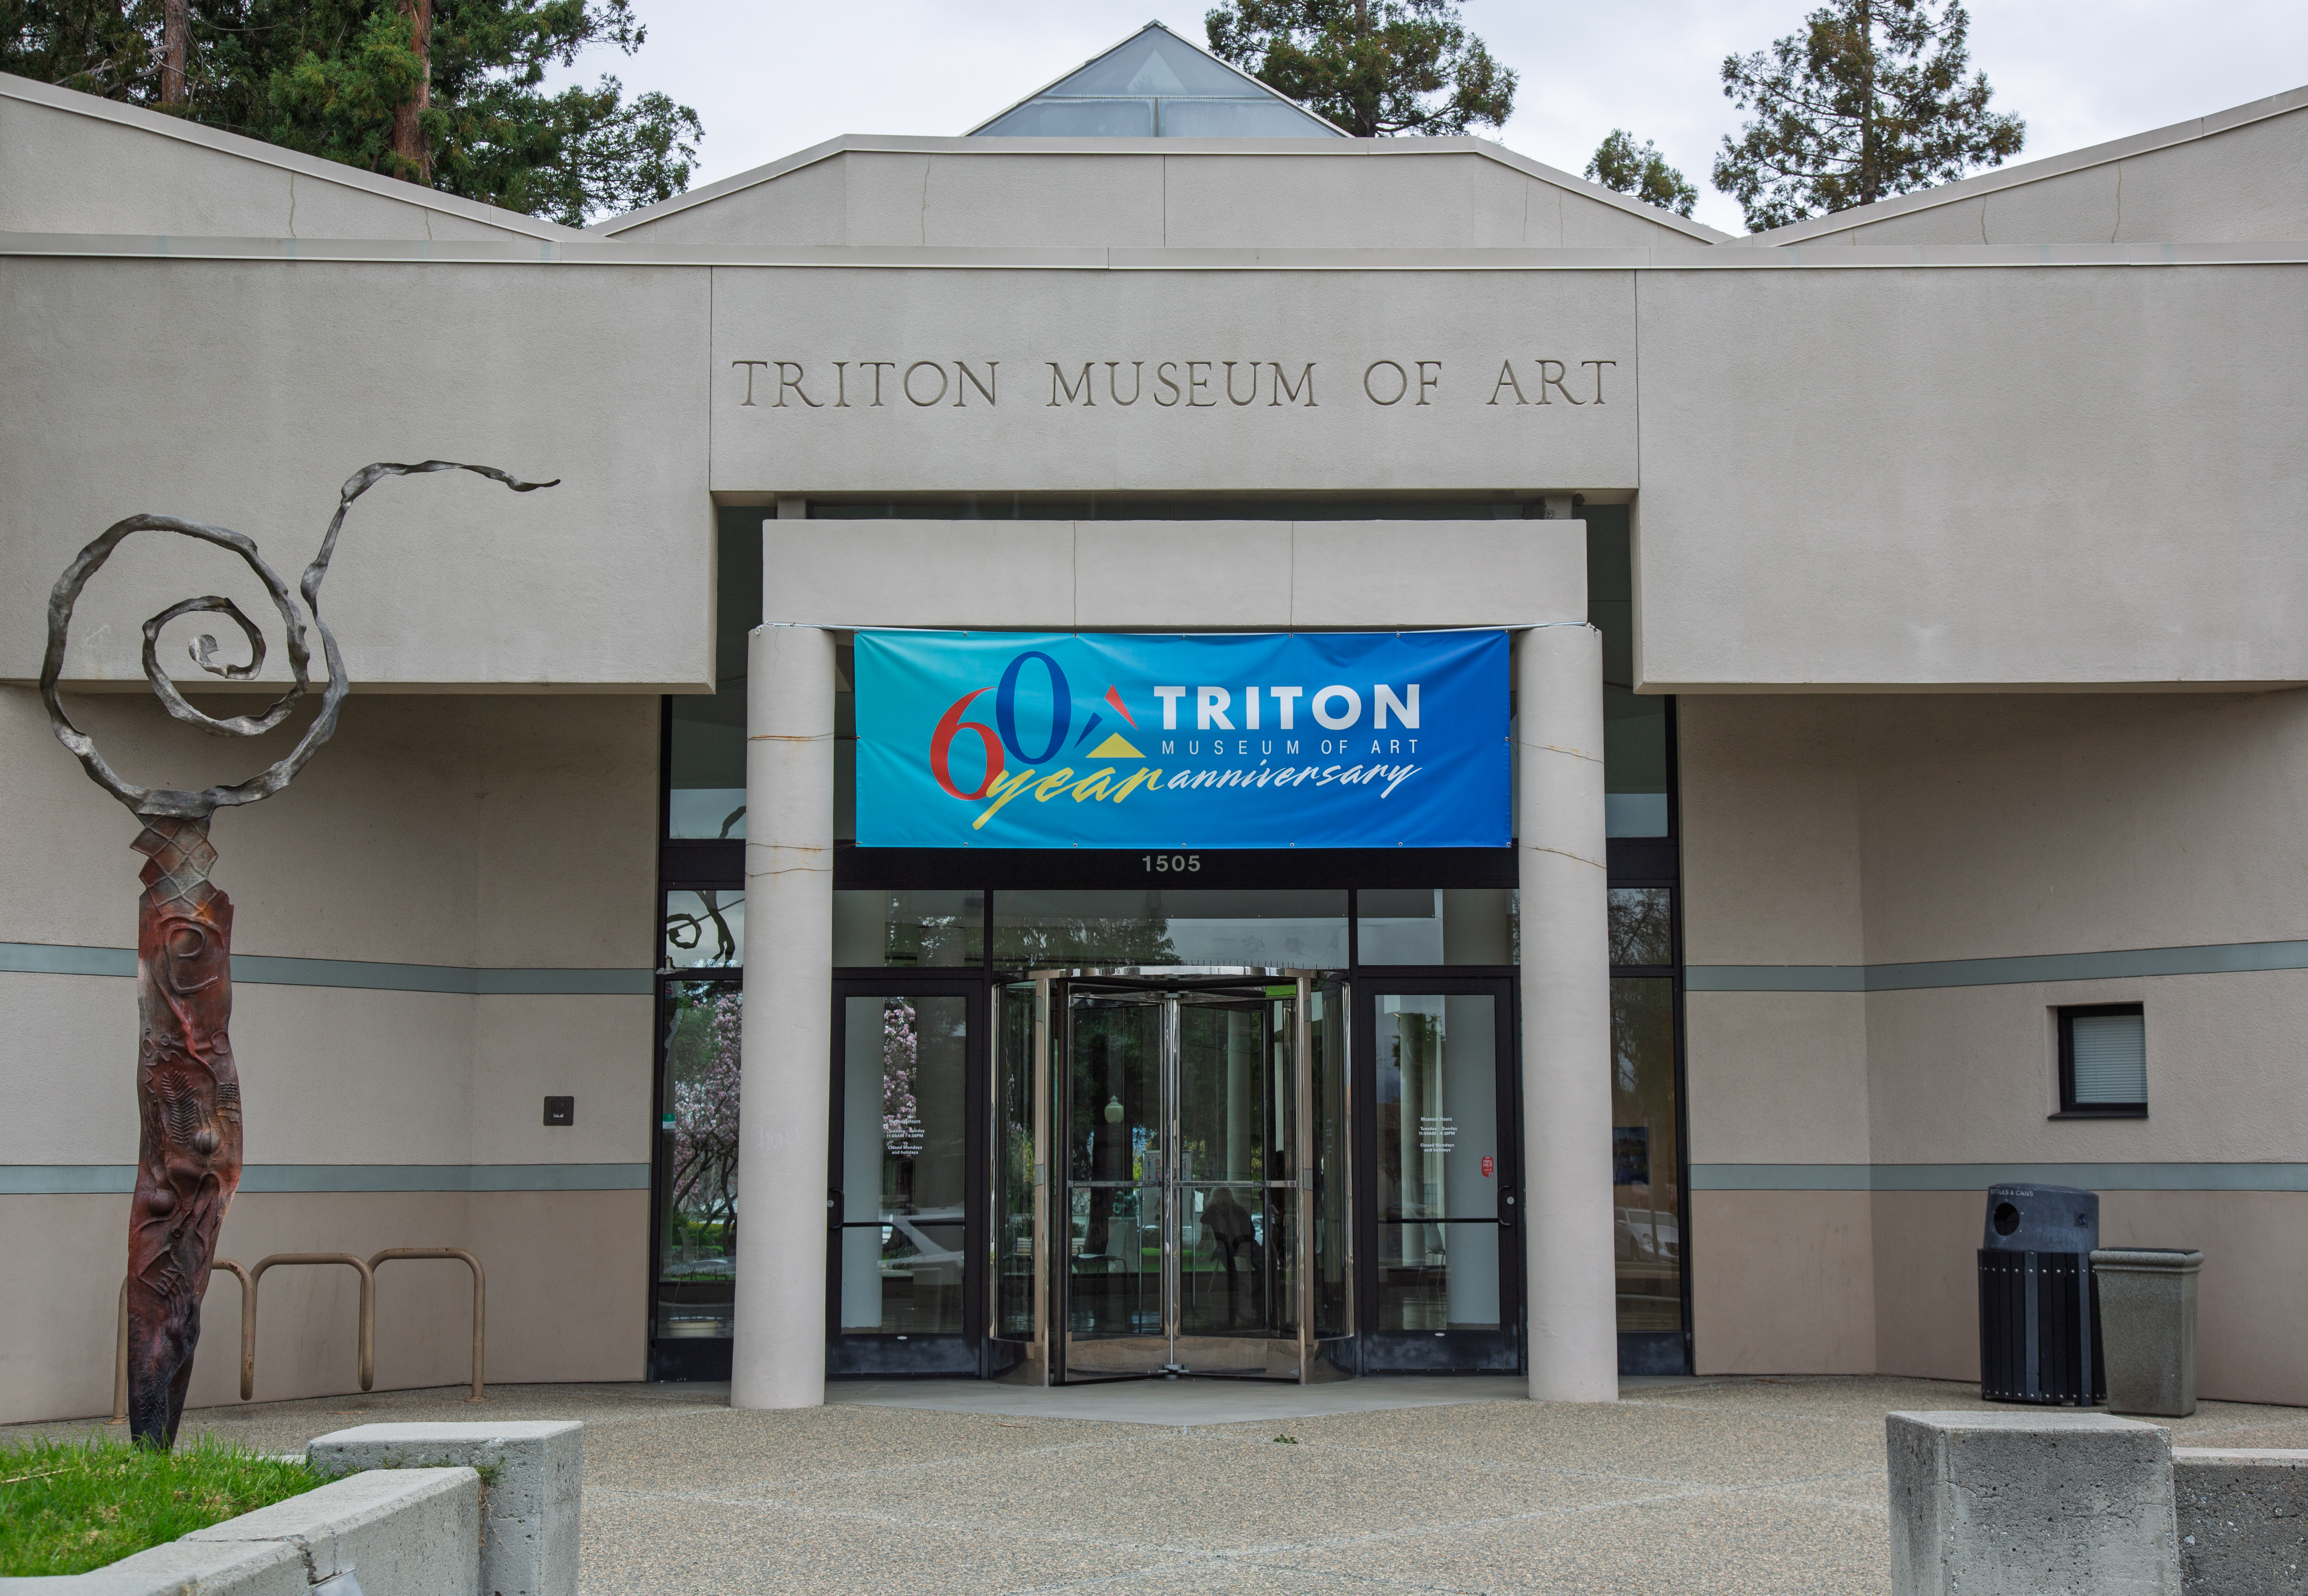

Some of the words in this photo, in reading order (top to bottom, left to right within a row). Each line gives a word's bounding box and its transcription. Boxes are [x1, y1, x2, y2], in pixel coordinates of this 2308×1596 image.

[732, 361, 999, 408] TRITON
[1044, 361, 1319, 407] MUSEUM
[1363, 360, 1442, 406] OF
[1486, 359, 1617, 405] ART
[930, 651, 1072, 800] 60
[1154, 684, 1420, 730] TRITON
[1162, 740, 1299, 754] MUSEUM
[1321, 740, 1348, 754] OF
[1371, 739, 1418, 754] ART
[972, 767, 1165, 830] year
[1167, 759, 1423, 799] anniversary
[1142, 855, 1201, 872] 1505
